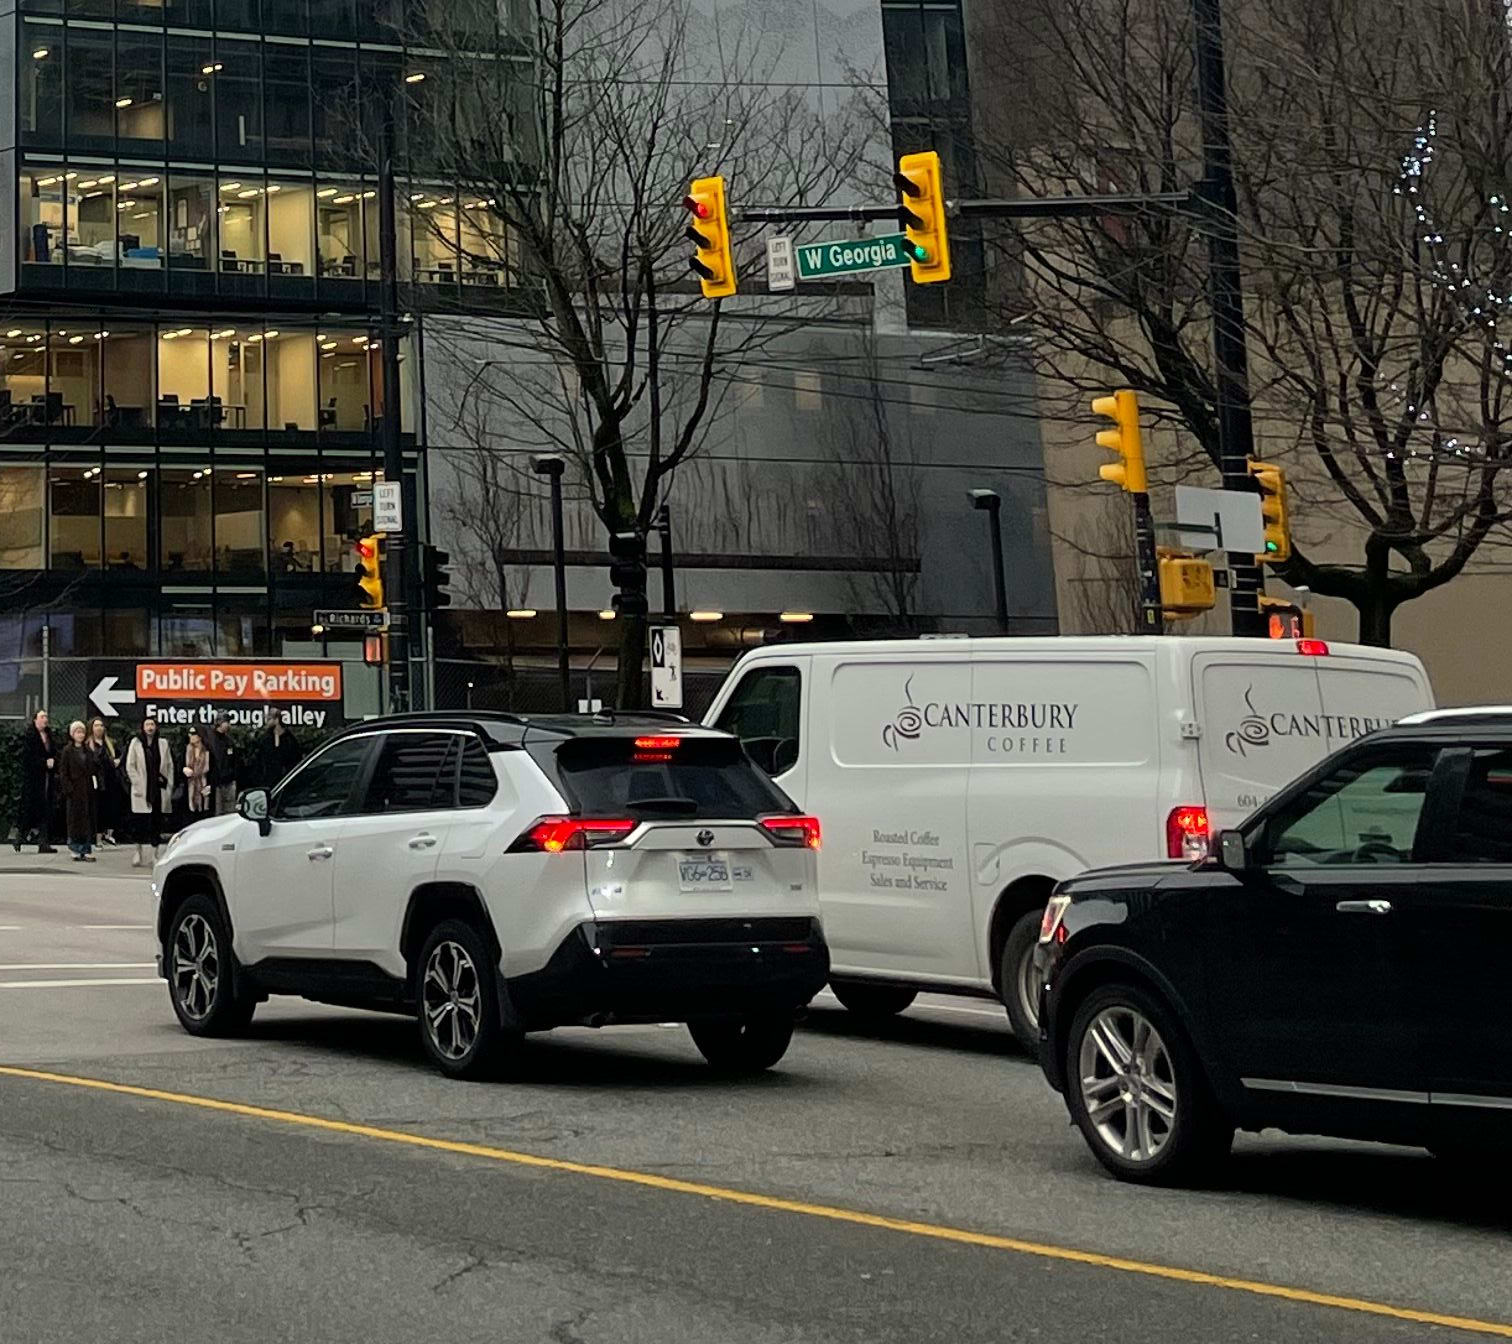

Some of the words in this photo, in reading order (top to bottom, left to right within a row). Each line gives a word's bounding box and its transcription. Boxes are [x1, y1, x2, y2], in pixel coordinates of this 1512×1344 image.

[805, 248, 823, 270] W
[829, 240, 897, 267] Georgia
[378, 488, 394, 499] LEFT
[329, 613, 371, 625] Richards
[141, 669, 206, 691] Public
[210, 670, 248, 696] Pay
[253, 670, 335, 697] Parking
[146, 703, 196, 724] Enter
[199, 703, 272, 729] thoug
[280, 704, 326, 729] alley
[924, 702, 1079, 729] CANTERBURY
[987, 736, 1067, 753] COFFEE
[872, 829, 908, 845] Roasted
[910, 831, 940, 846] Coffee
[862, 850, 900, 869] Espresso
[902, 852, 953, 872] Equipment
[870, 873, 892, 888] Sales
[895, 875, 912, 889] and
[913, 876, 948, 892] Service
